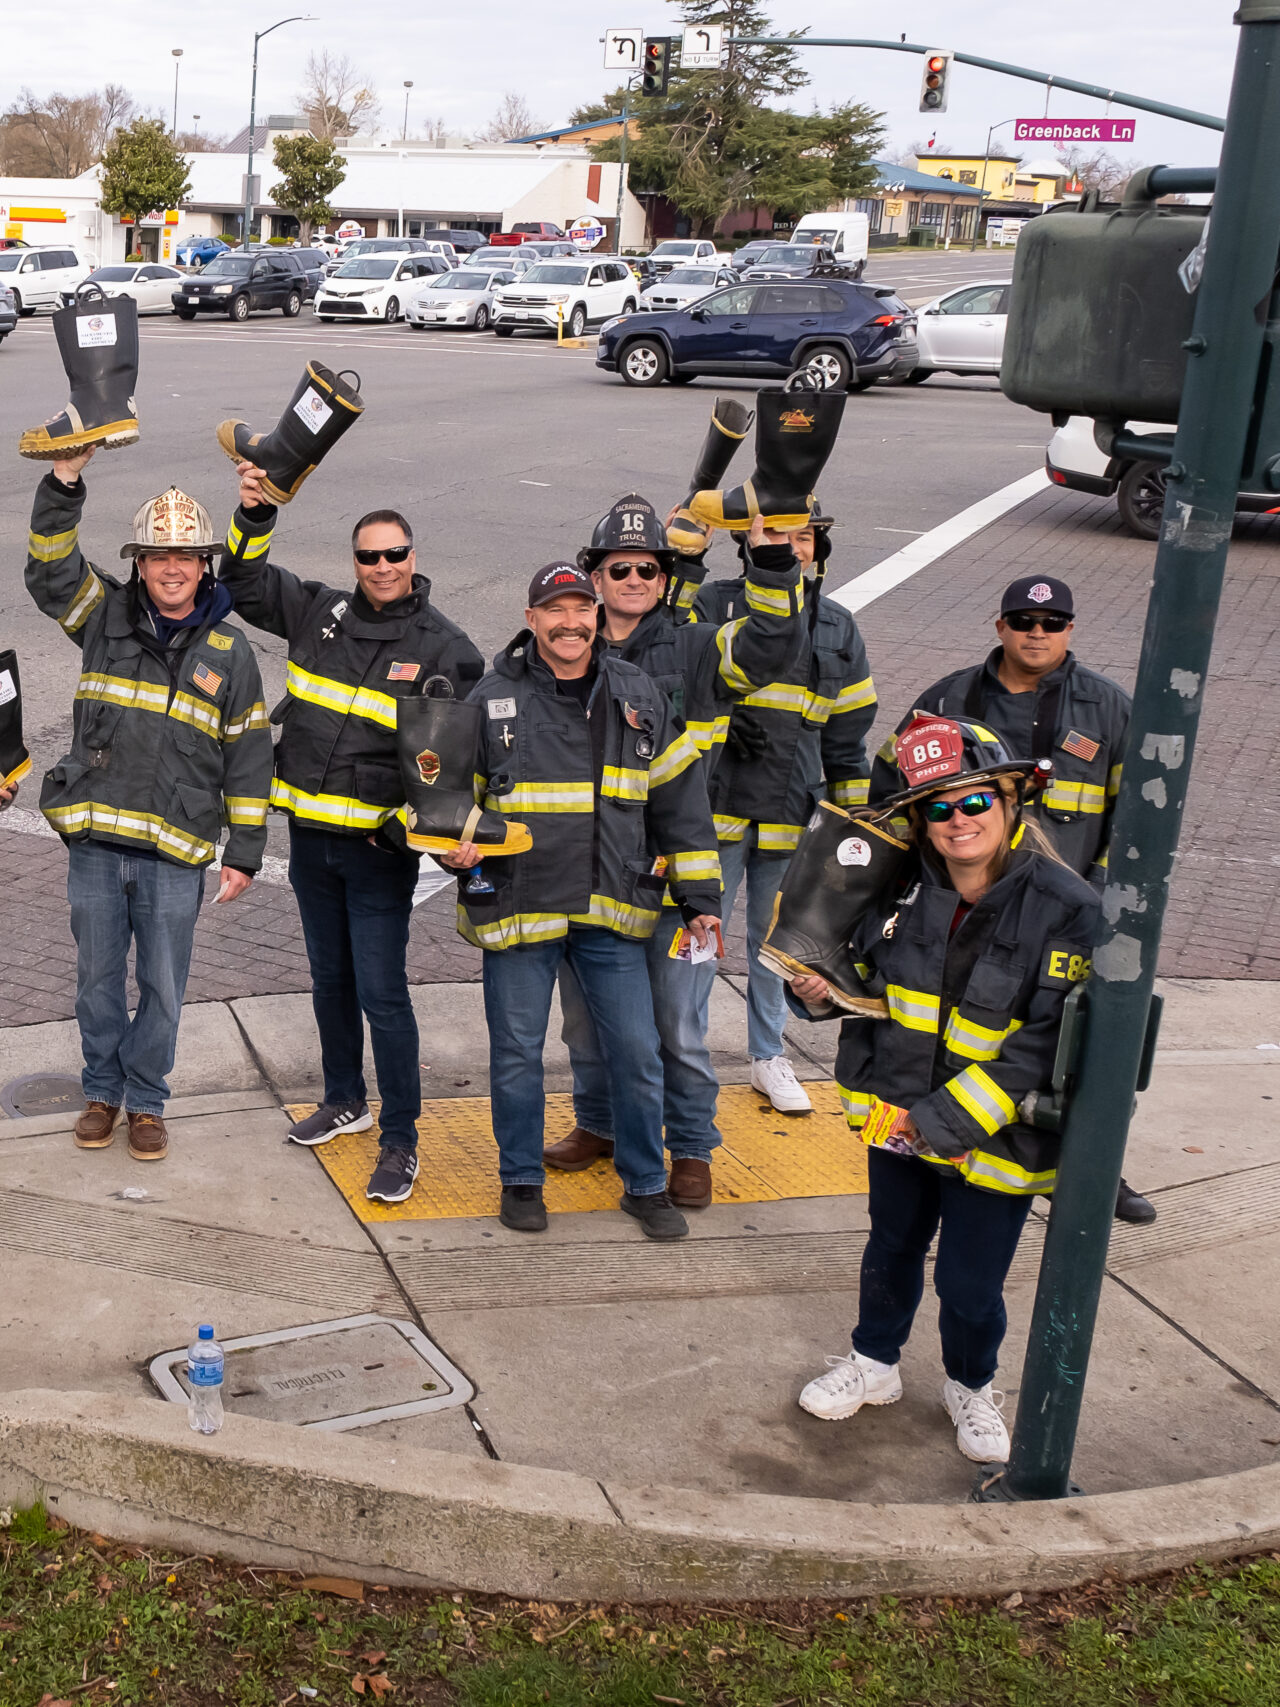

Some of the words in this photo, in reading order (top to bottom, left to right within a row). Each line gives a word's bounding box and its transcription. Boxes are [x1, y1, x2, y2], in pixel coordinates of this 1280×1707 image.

[1017, 123, 1100, 139] Greenback
[1111, 124, 1132, 139] Ln
[154, 502, 194, 515] SACRMENTO
[615, 503, 650, 514] SACRAMENTO
[622, 513, 644, 532] 16
[619, 533, 646, 542] TRUCK
[541, 566, 586, 585] SACRAMENTO
[554, 573, 577, 585] FIRE
[915, 723, 950, 736] OFFICER
[913, 740, 942, 764] 86
[915, 763, 949, 779] PHFD
[272, 1369, 346, 1390] ELECTRICAL
